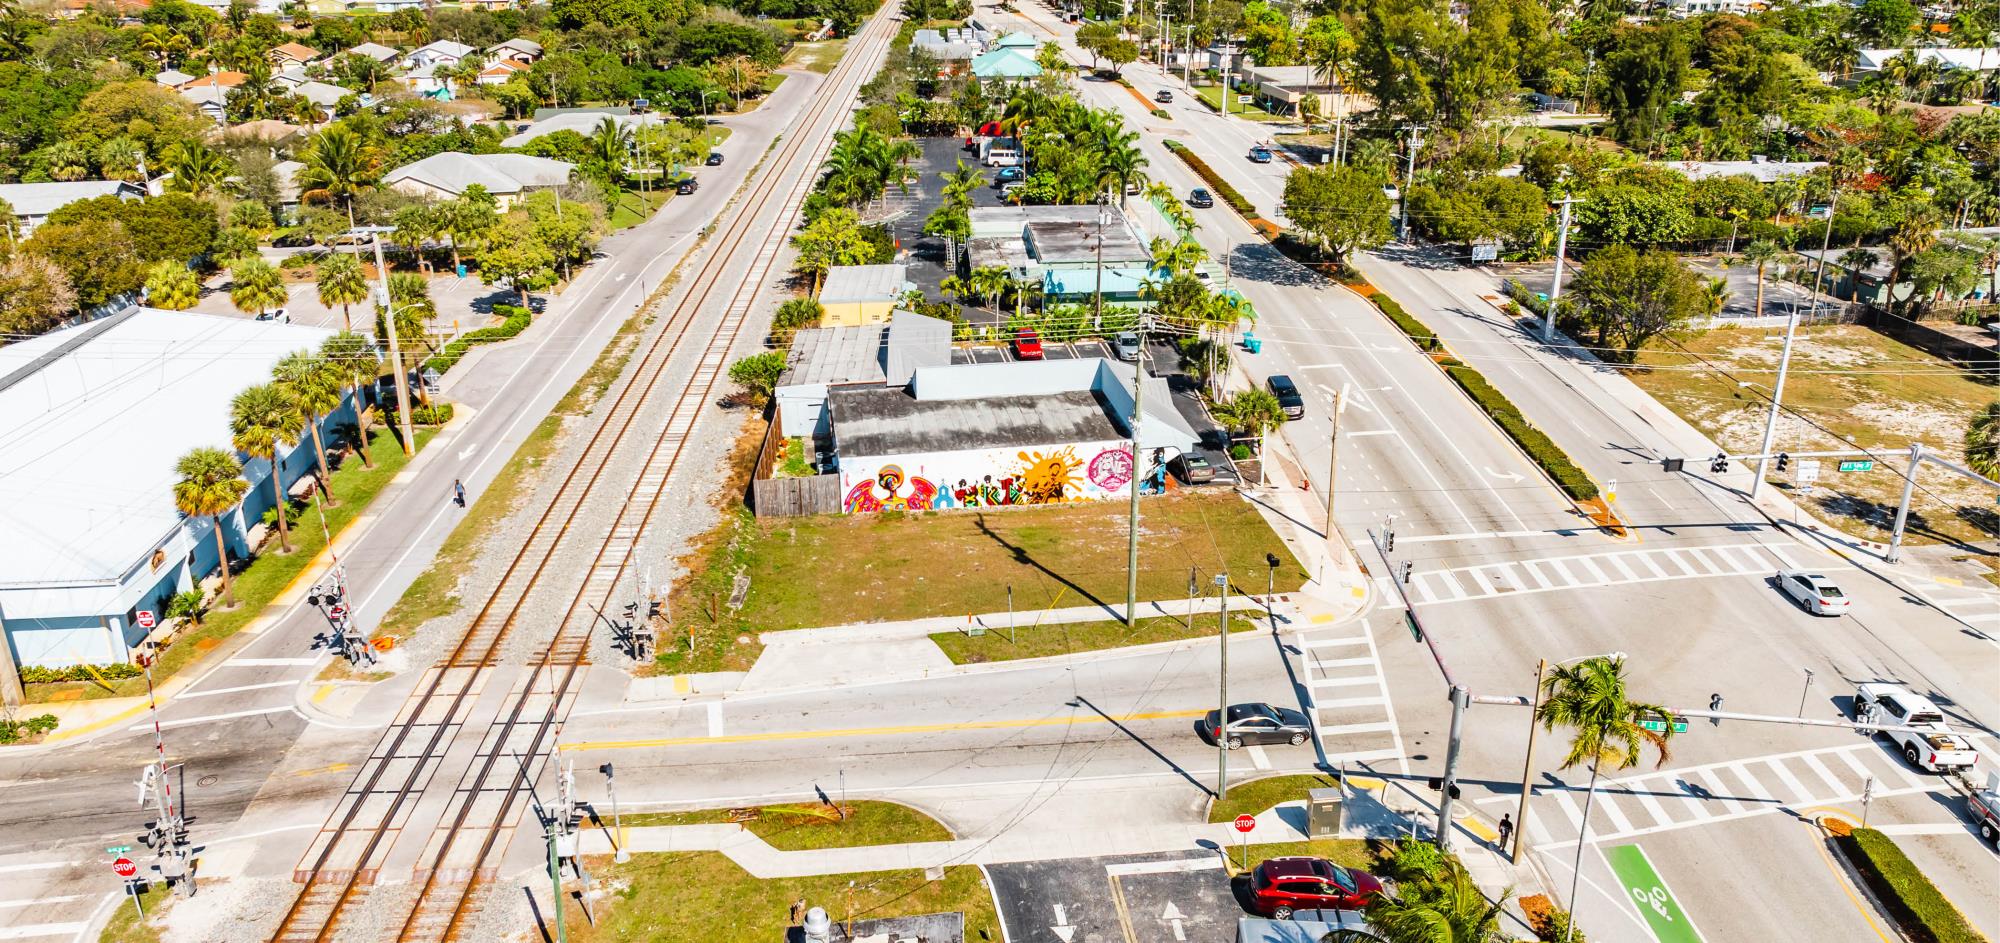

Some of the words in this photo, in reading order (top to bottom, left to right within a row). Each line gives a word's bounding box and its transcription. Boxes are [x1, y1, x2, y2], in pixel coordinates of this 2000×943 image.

[1096, 458, 1127, 479] LOVE
[1236, 820, 1254, 828] STOP
[114, 863, 134, 871] STOP
